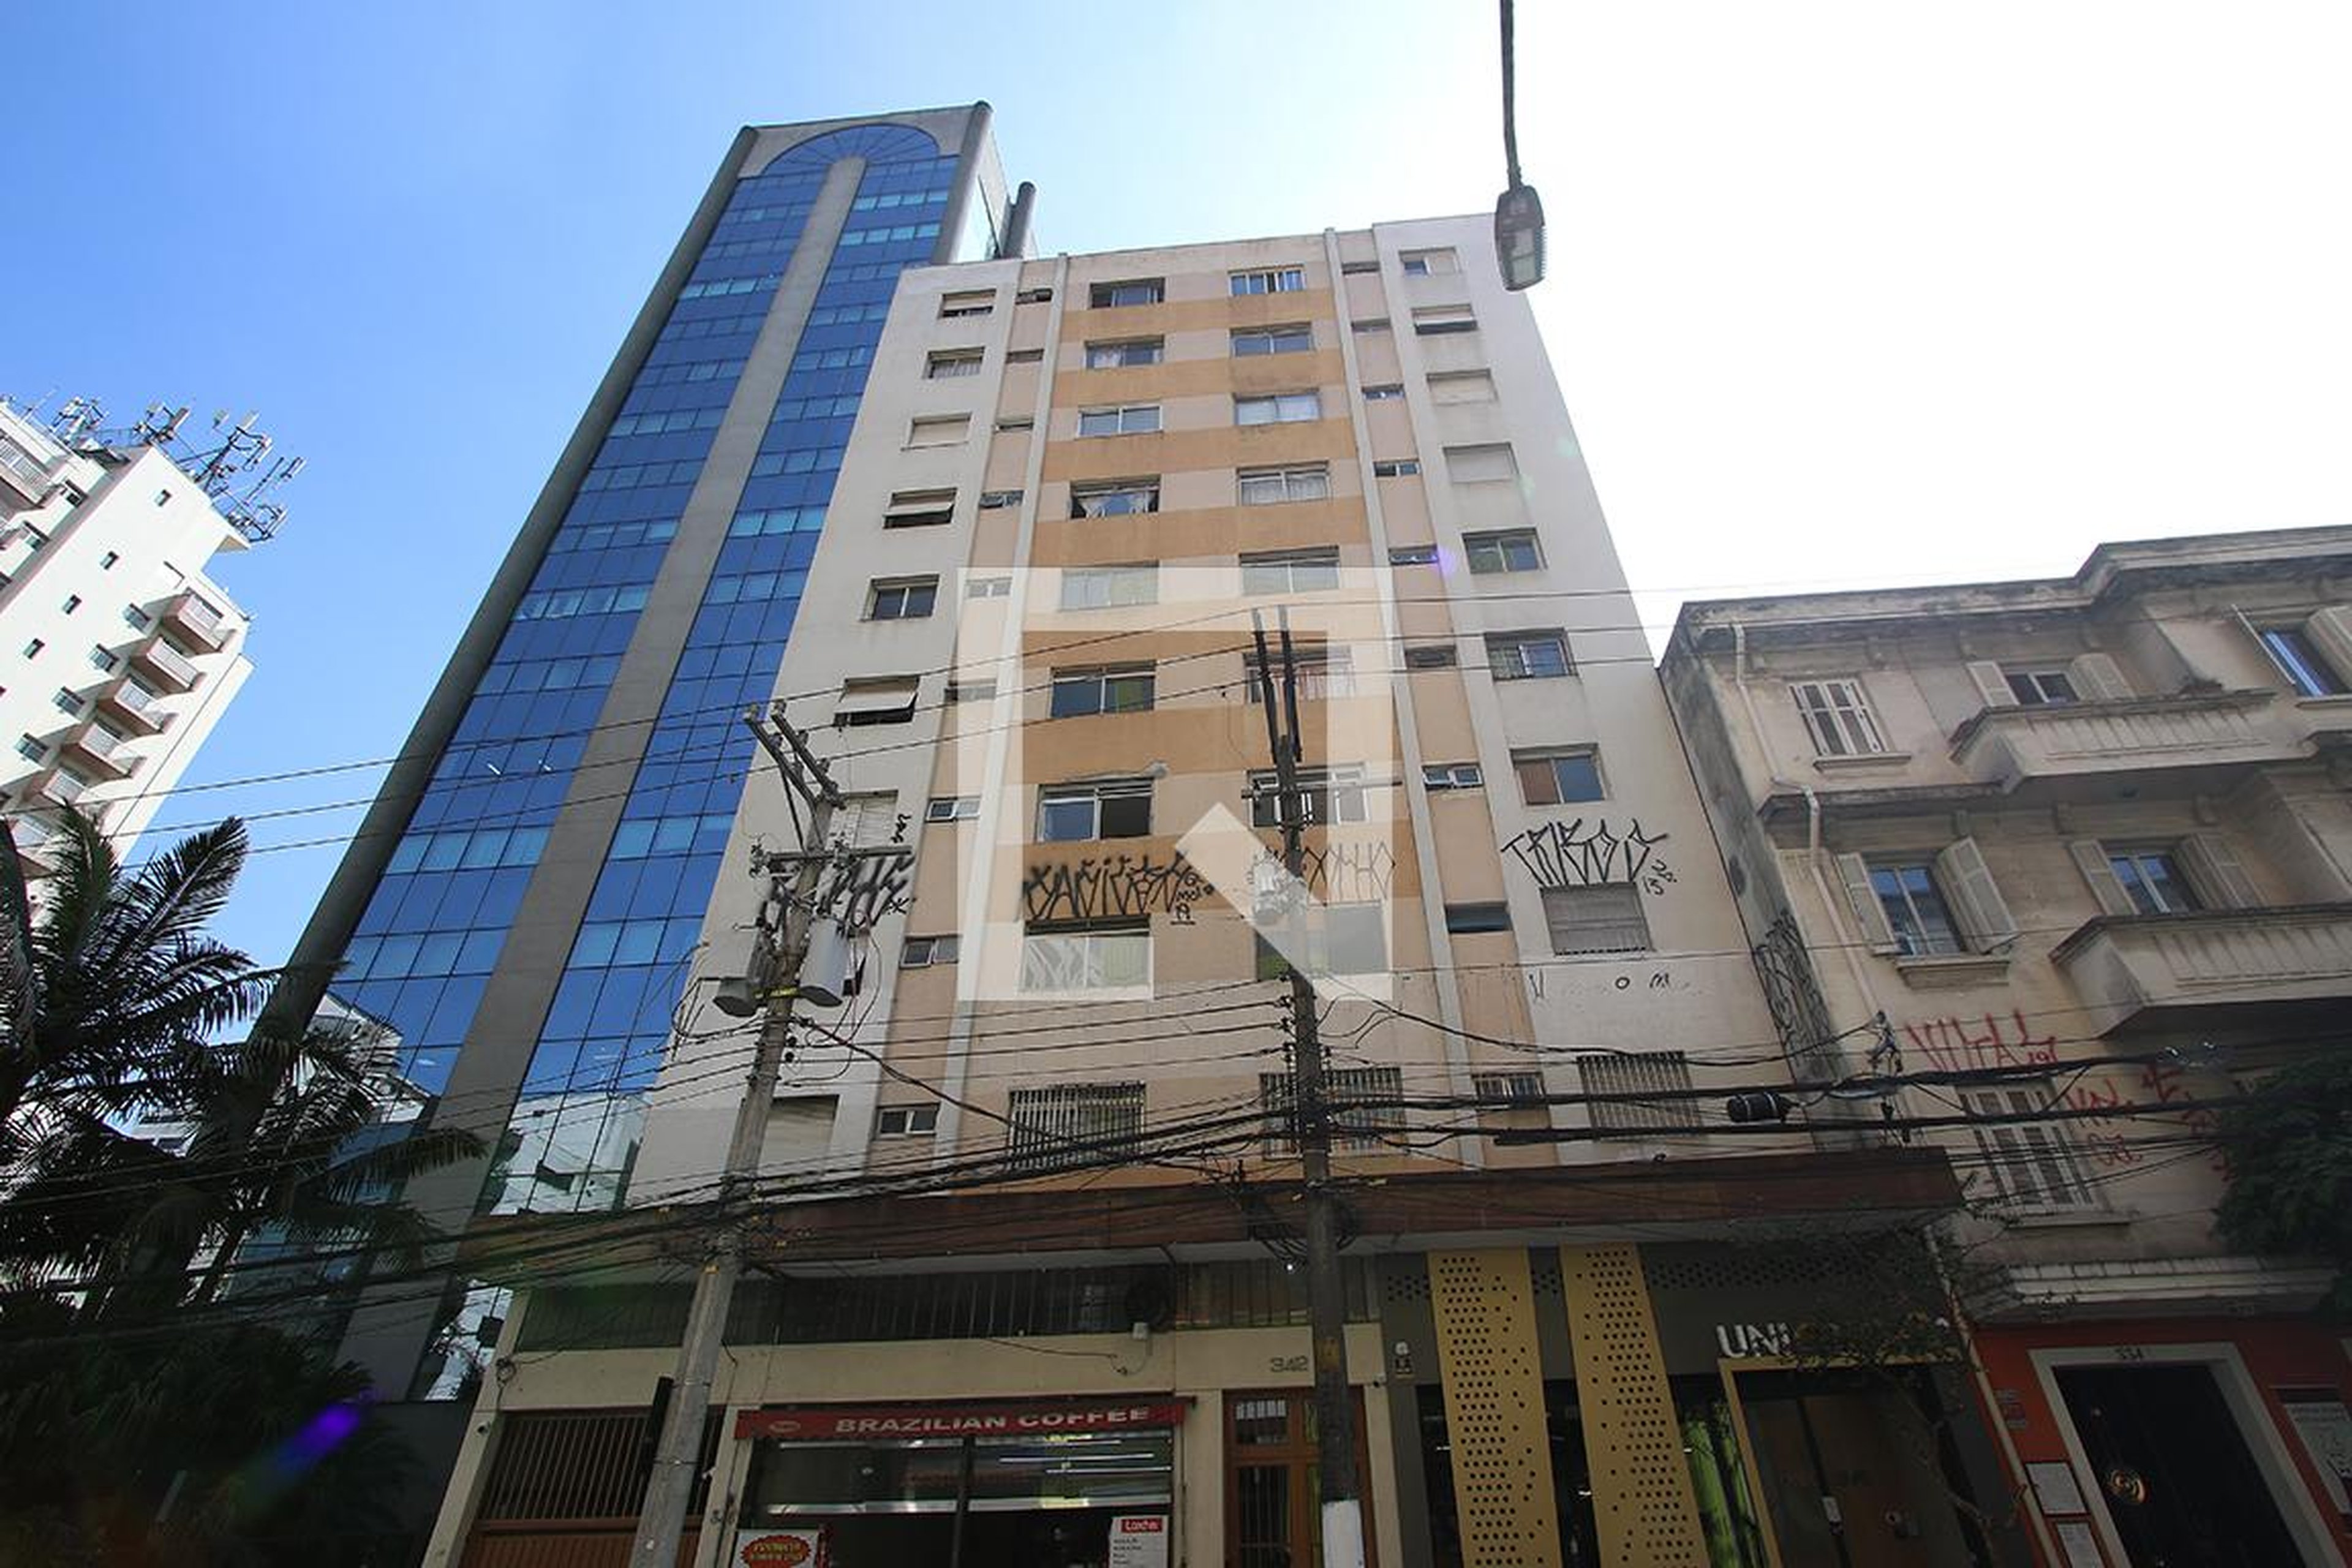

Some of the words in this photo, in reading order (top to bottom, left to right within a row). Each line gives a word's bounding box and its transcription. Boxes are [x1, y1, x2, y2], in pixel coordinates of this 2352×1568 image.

[1270, 1355, 1308, 1373] 342
[835, 1414, 1006, 1434] BRAZILIAN
[1018, 1407, 1149, 1428] COFFEE
